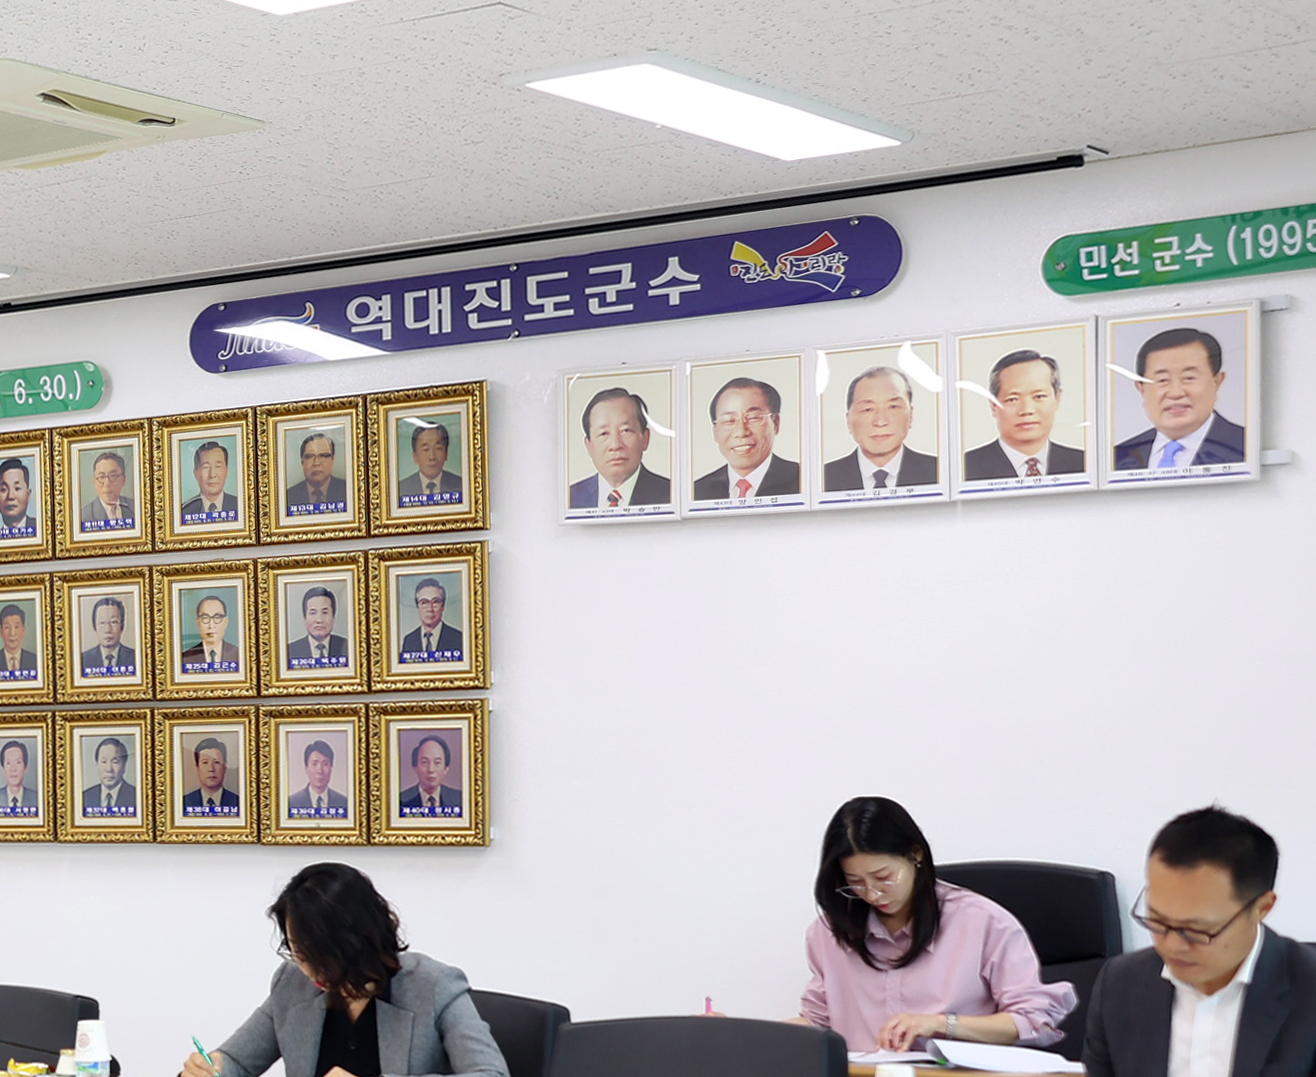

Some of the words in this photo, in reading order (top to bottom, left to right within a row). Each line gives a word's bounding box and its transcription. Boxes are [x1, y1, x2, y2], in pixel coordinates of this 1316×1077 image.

[1079, 241, 1140, 281] 민선
[1152, 233, 1214, 273] 군수
[345, 256, 703, 341] 역대진도군수
[14, 379, 34, 406] 6.
[40, 371, 82, 403] 30.)
